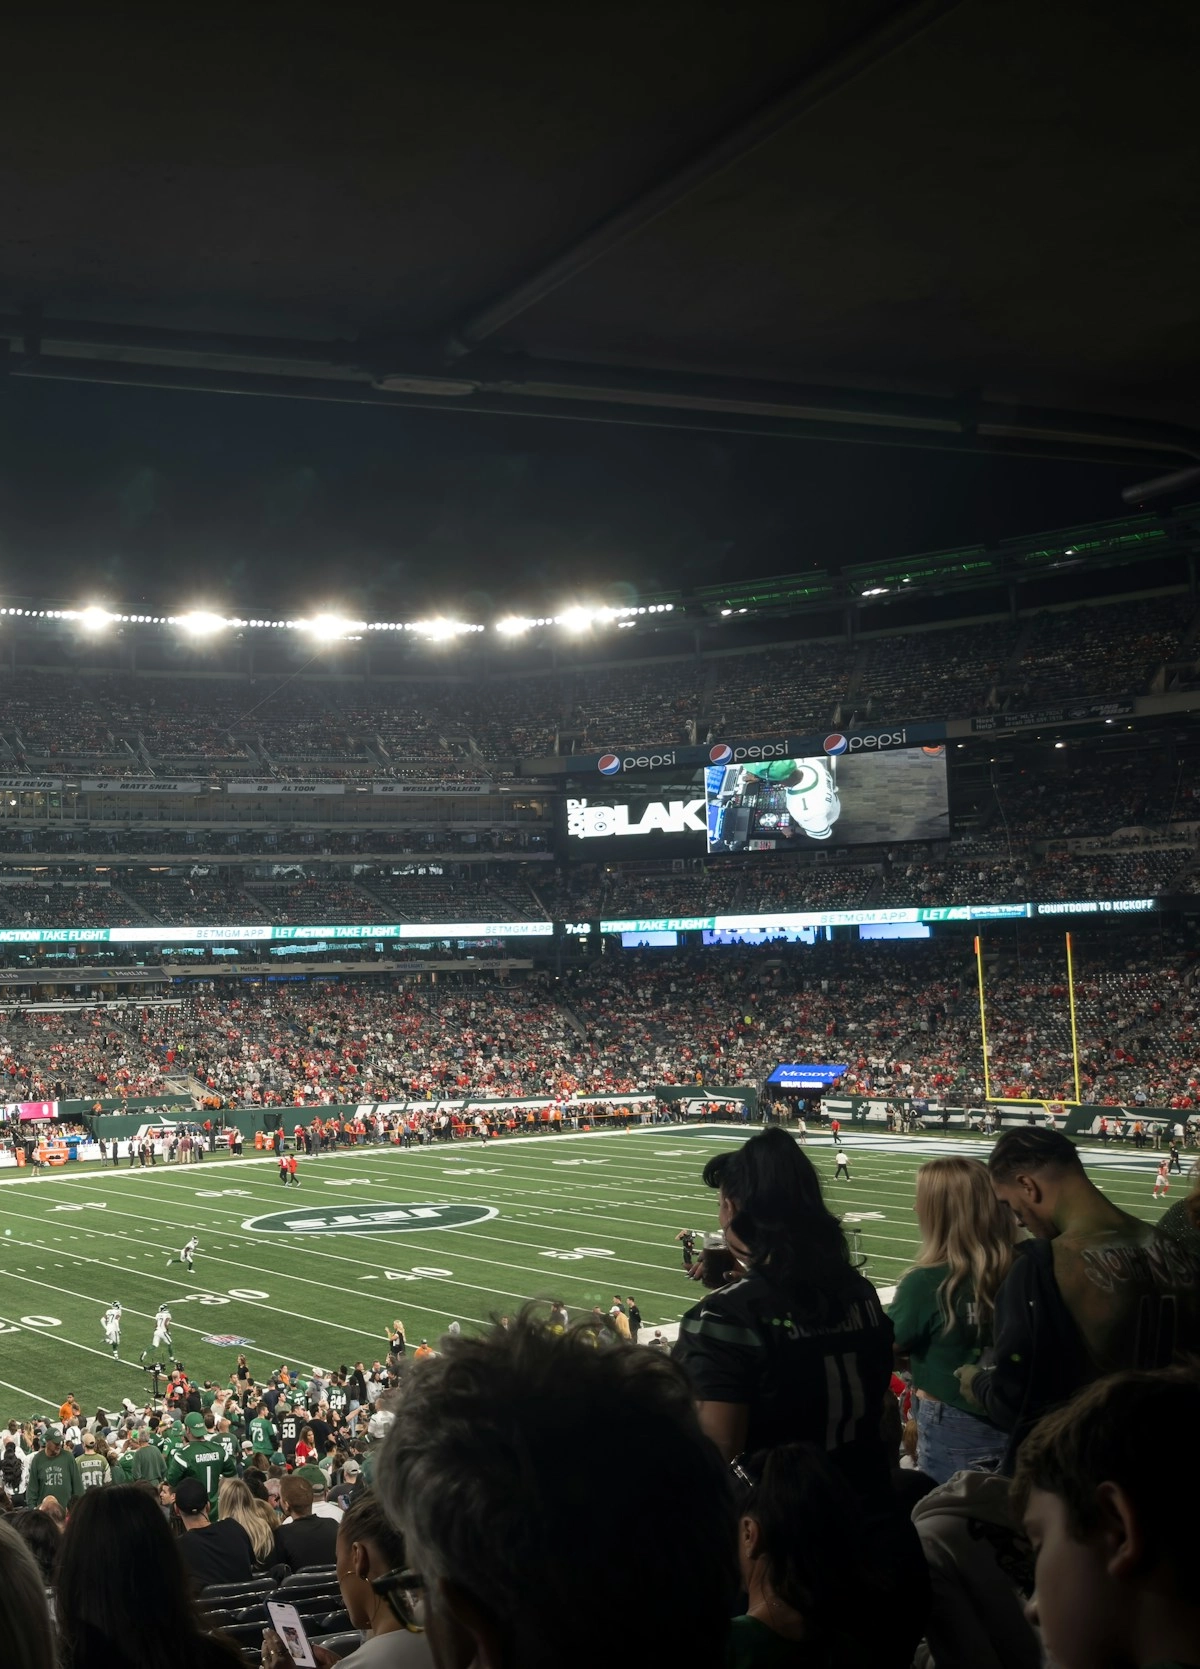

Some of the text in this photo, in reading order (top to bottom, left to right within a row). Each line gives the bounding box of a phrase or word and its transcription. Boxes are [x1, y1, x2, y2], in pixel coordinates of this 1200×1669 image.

[849, 728, 906, 752] pepsi
[734, 740, 789, 762] pepsi
[623, 751, 676, 772] pepsi
[567, 798, 587, 809] DJ
[1038, 899, 1154, 914] COUNTDOWN TO KICKOFF
[820, 913, 876, 923] BETMGM
[923, 909, 947, 920] LET
[275, 928, 294, 937] LET
[294, 927, 335, 937] ACTION
[335, 926, 361, 936] TAKE
[485, 925, 528, 933] BETMGM
[638, 920, 668, 931] TAKE
[41, 930, 69, 941] TAKE
[196, 929, 240, 938] BETMGM
[537, 1247, 616, 1260] 50
[383, 1267, 454, 1281] 40
[185, 1289, 270, 1305] 30
[330, 1394, 347, 1410] 24
[823, 1351, 866, 1452] 11
[251, 1427, 264, 1442] 73
[282, 1423, 296, 1439] 58
[195, 1451, 220, 1463] GARDNER
[44, 1473, 63, 1486] JETS
[206, 1466, 211, 1494] 1
